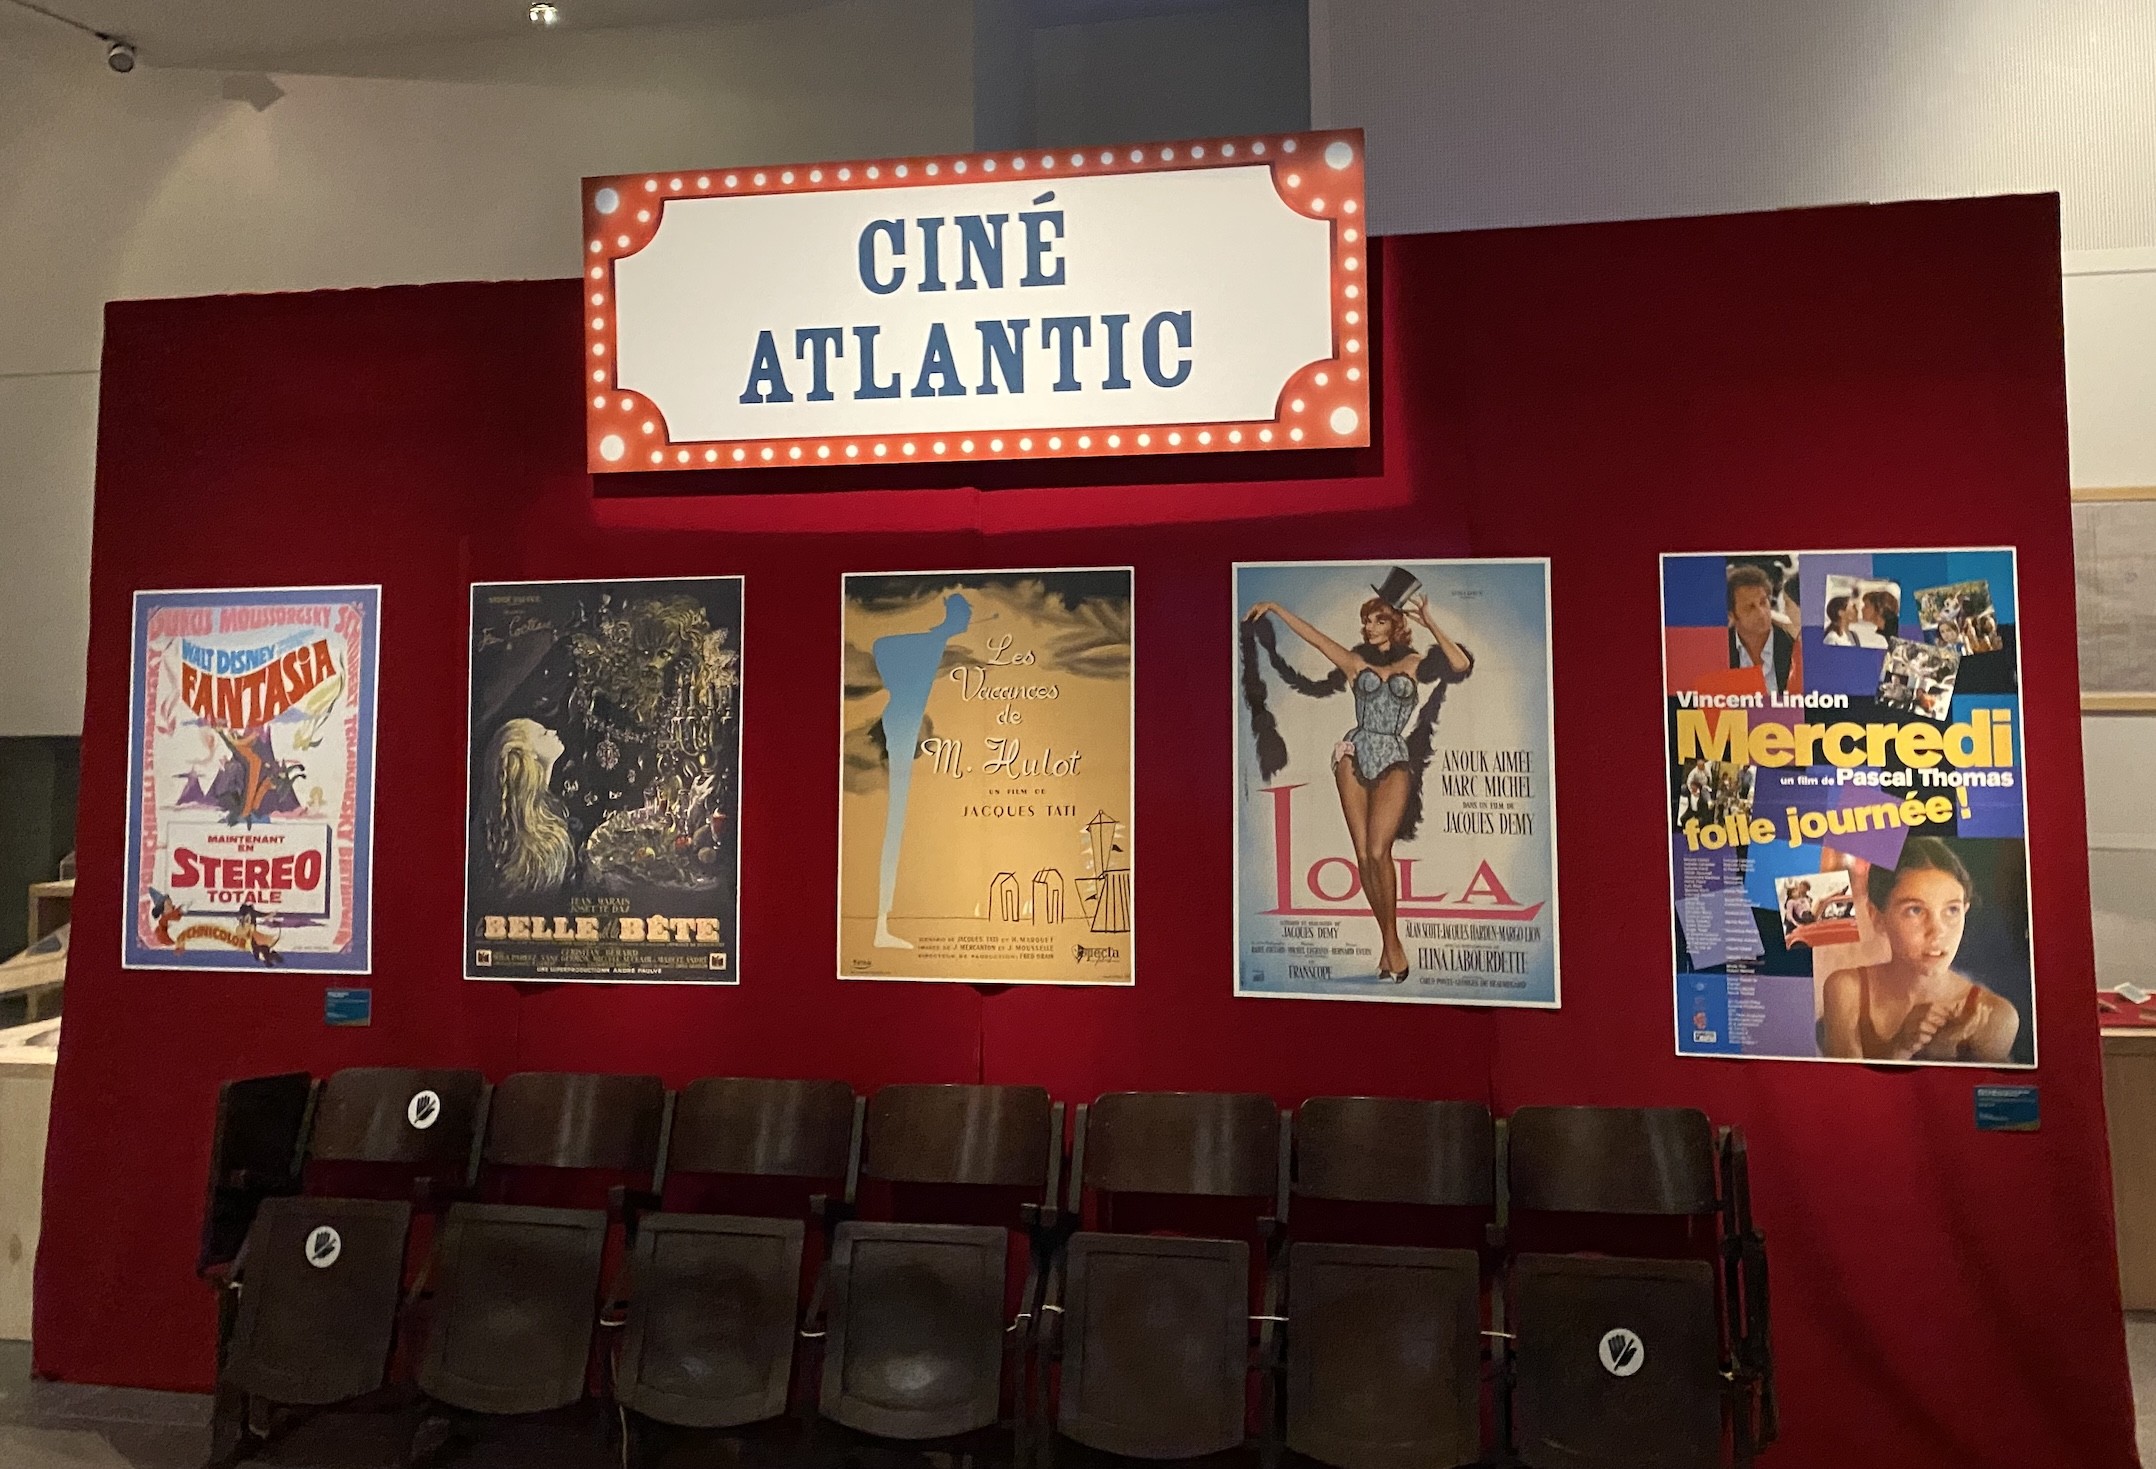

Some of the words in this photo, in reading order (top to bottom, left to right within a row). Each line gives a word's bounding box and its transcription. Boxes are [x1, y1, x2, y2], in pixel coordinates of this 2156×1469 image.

[858, 190, 1067, 294] CINÉ
[738, 309, 1194, 405] ATLANTIC
[182, 637, 214, 670] WALT
[216, 642, 276, 676] DISNEY
[986, 633, 1036, 667] Les
[181, 638, 337, 729] FANTASIA
[950, 666, 1060, 702] Vacances
[1676, 691, 1763, 709] Vincent
[1771, 690, 1848, 709] Lindon
[996, 703, 1023, 725] de
[1676, 709, 2013, 768] Mercredi
[920, 737, 974, 779] M.
[982, 737, 1083, 780] Hulot
[1442, 750, 1489, 772] ANOUK
[1493, 749, 1535, 773] AIMÉE
[1442, 774, 1478, 797] MARC
[1485, 775, 1535, 798] MICHEL
[1780, 777, 1795, 786] un
[1797, 775, 1818, 786] film
[1821, 775, 1835, 786] de
[1836, 768, 1912, 787] Pascal
[1919, 769, 2014, 788] Thomas
[962, 805, 1035, 818] JACQUES
[1047, 805, 1077, 817] TATI
[1443, 811, 1494, 835] JACQUES
[1500, 813, 1535, 835] DEMY
[1683, 812, 1776, 851] folle
[1786, 791, 1954, 849] journée
[207, 835, 286, 844] MAINTENANT
[237, 844, 254, 852] EN
[1256, 783, 1545, 921] LOLA
[171, 847, 322, 891] STEREO
[207, 890, 283, 904] TOTALE
[484, 915, 600, 941] BELLE
[619, 914, 720, 942] BÊTE
[1281, 926, 1314, 940] JACQUES
[1317, 927, 1340, 939] DEMY
[1418, 948, 1448, 970] ELINA
[1450, 948, 1529, 974] LABOURDETTE
